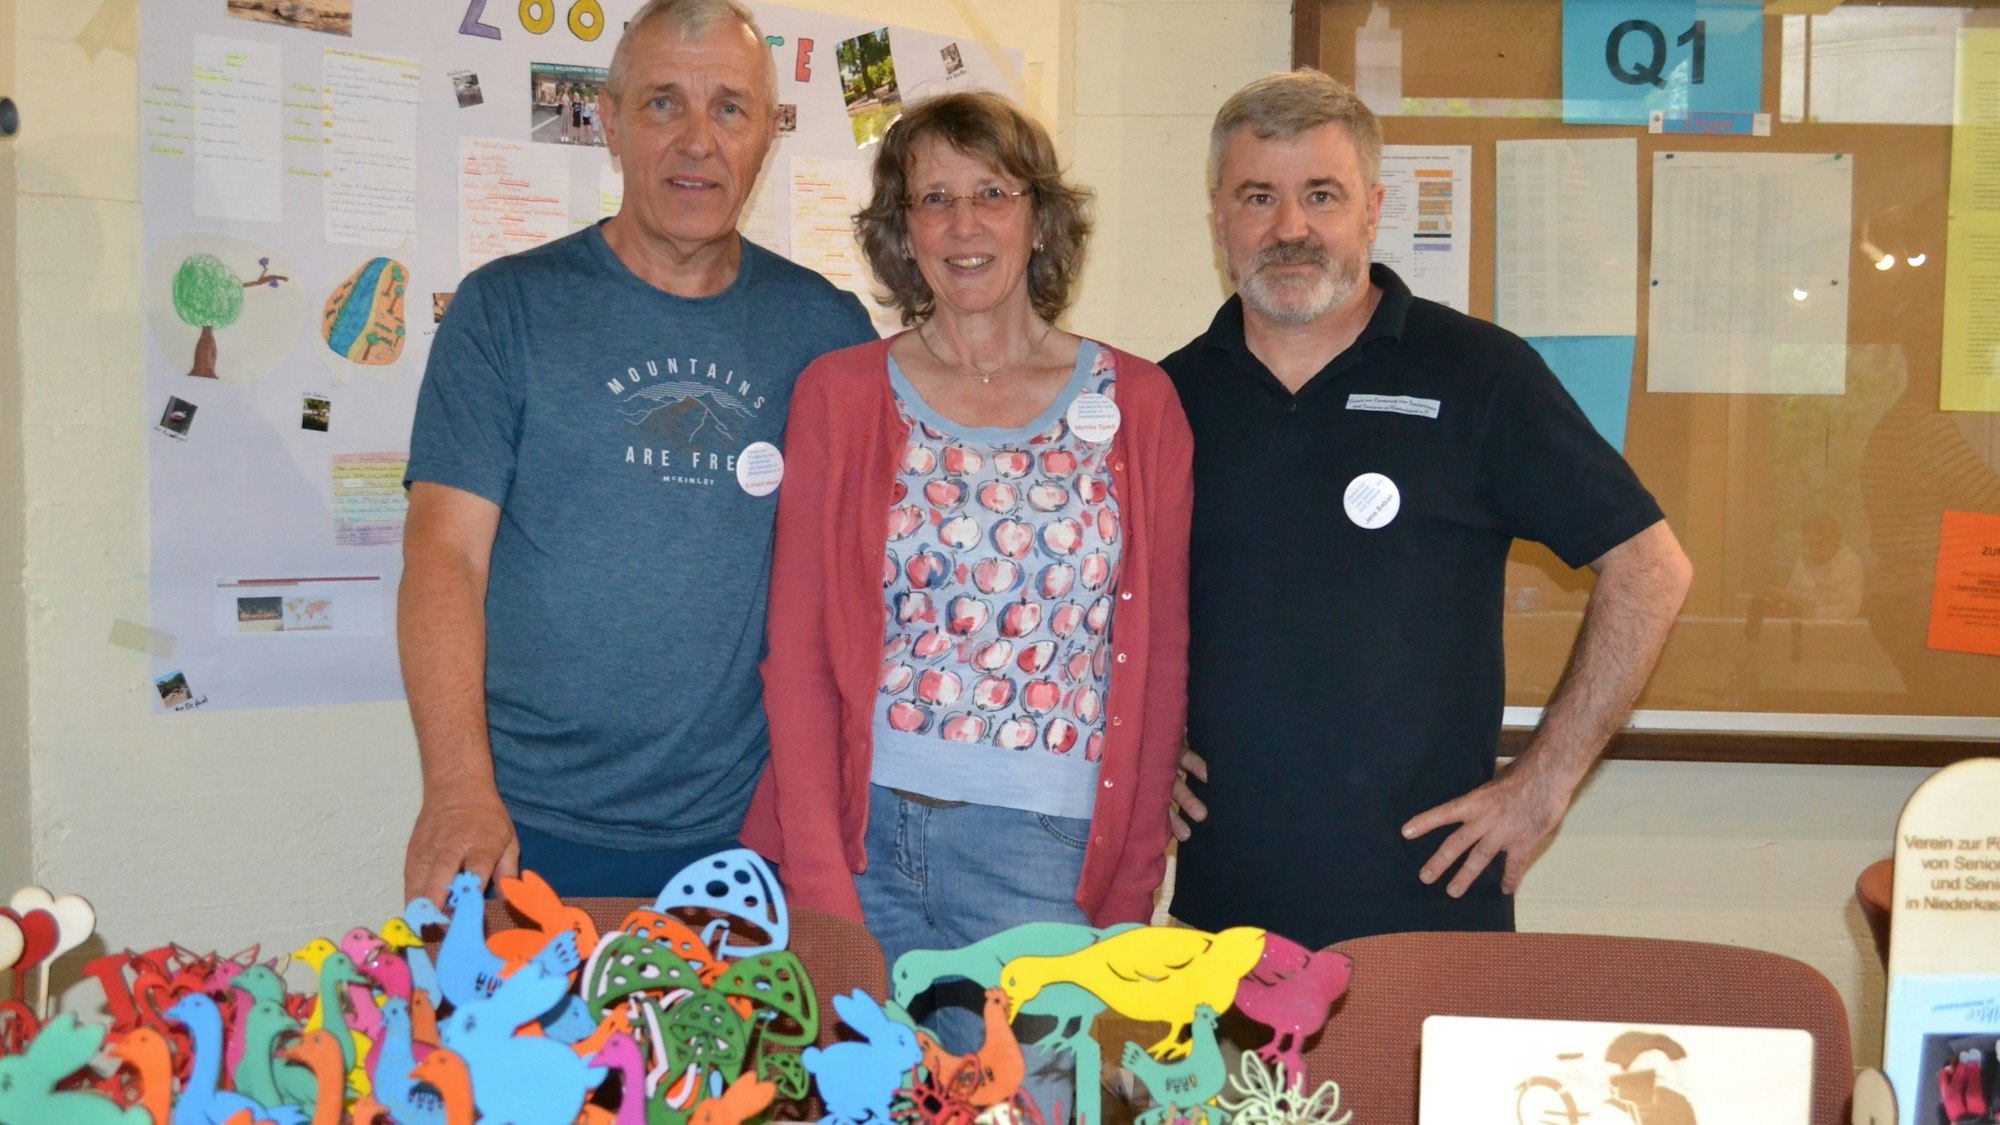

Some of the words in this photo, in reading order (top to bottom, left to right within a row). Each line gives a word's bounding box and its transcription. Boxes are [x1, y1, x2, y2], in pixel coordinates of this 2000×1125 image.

[1605, 19, 1706, 90] Q1
[607, 358, 765, 409] MOUNTAINS
[625, 446, 671, 467] ARE
[1904, 835, 1953, 850] Verein
[1957, 839, 1982, 850] zur
[1921, 859, 1949, 870] von
[1931, 877, 1961, 890] und
[1905, 896, 1920, 909] in
[1923, 896, 2000, 911] Niederkas
